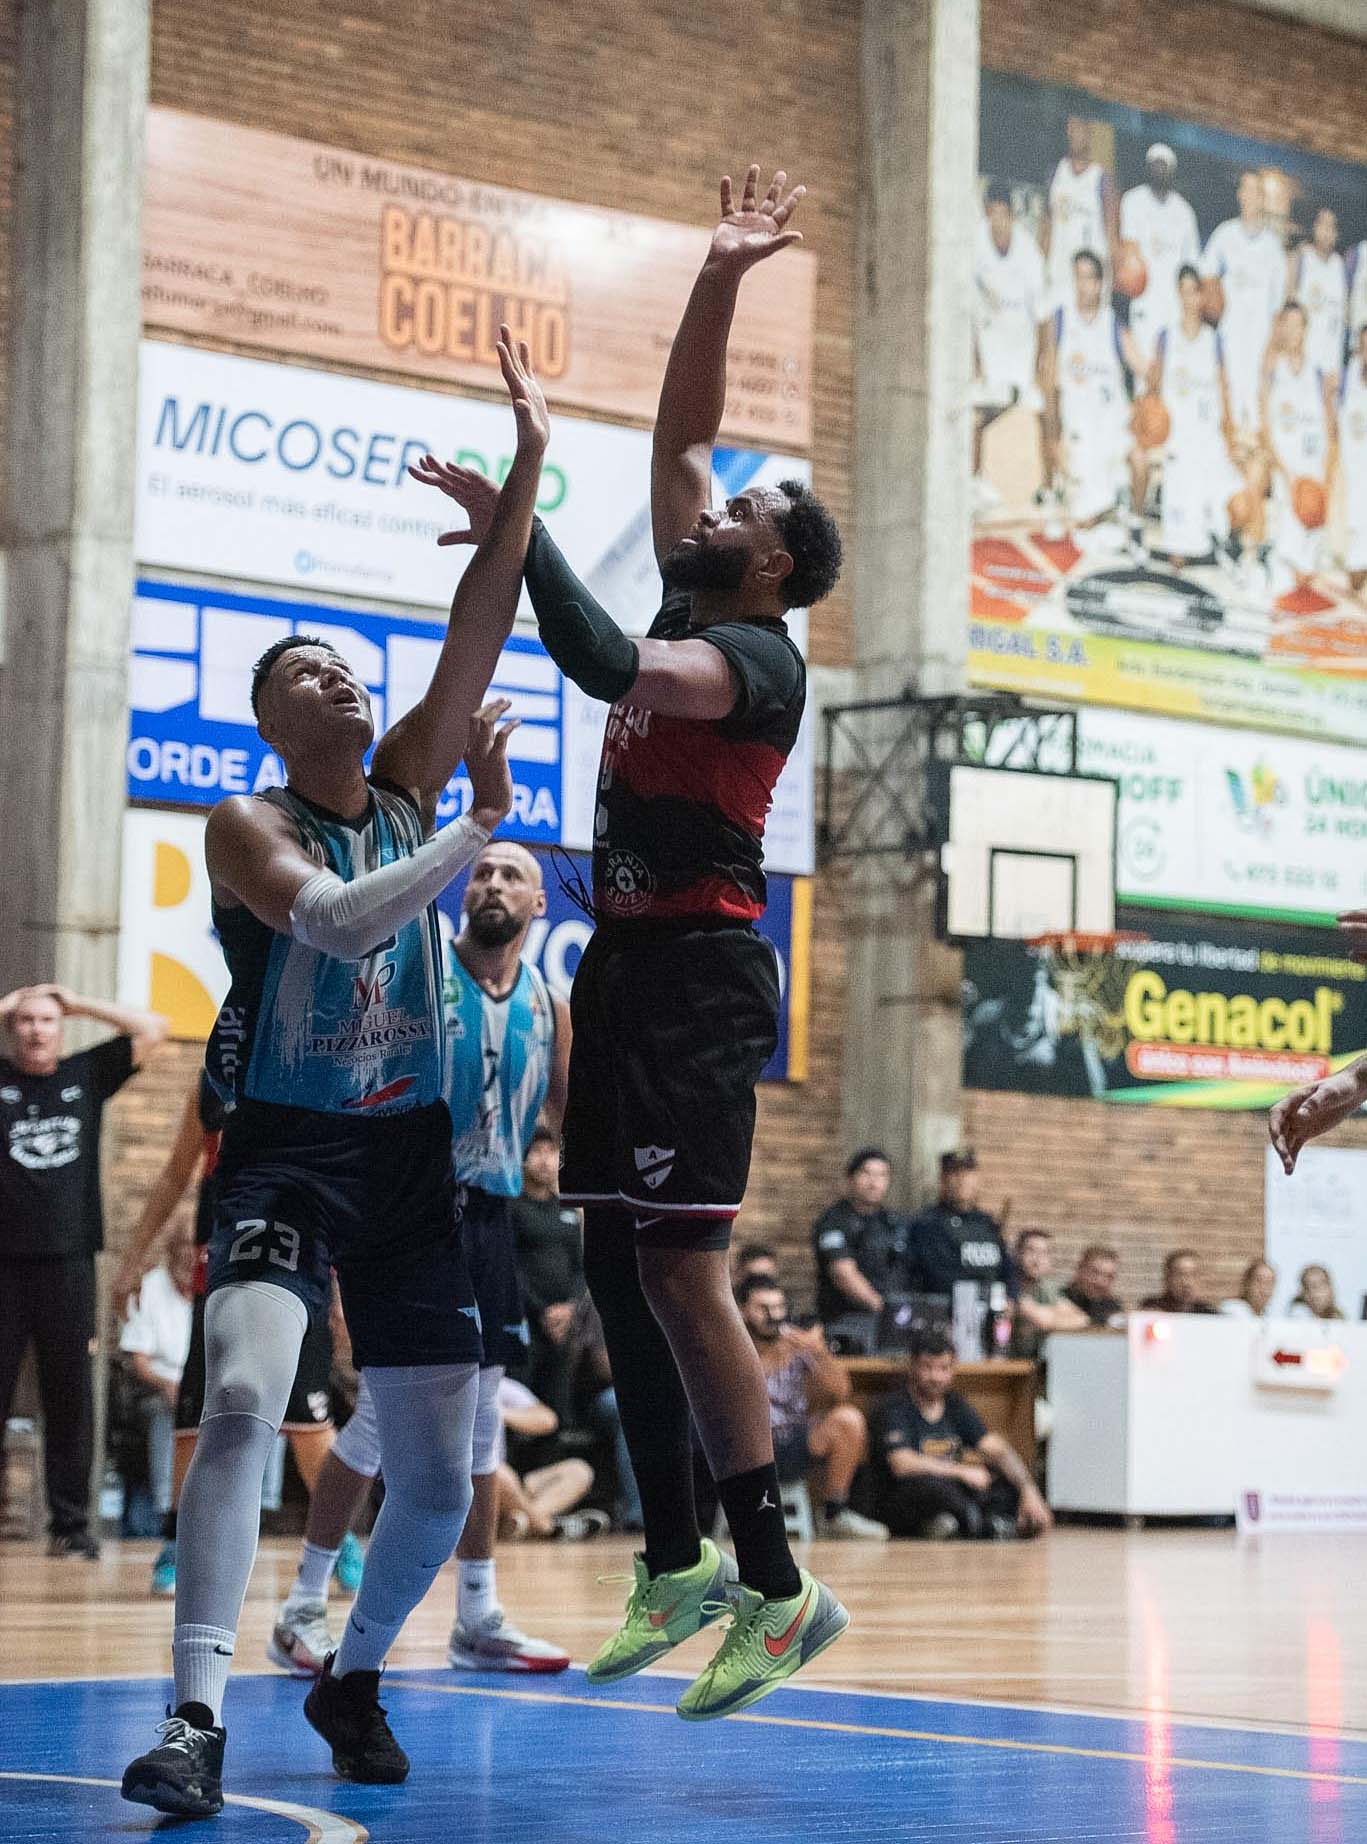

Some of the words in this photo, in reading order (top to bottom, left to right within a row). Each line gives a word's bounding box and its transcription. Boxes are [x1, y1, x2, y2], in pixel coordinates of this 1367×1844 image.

[314, 155, 352, 188] UN
[361, 165, 463, 205] MUNDO
[379, 272, 569, 378] COELHO
[177, 484, 251, 508] aerosol
[337, 1008, 408, 1035] MIGUEL
[1125, 970, 1333, 1053] Genacol
[228, 1219, 300, 1271] 23
